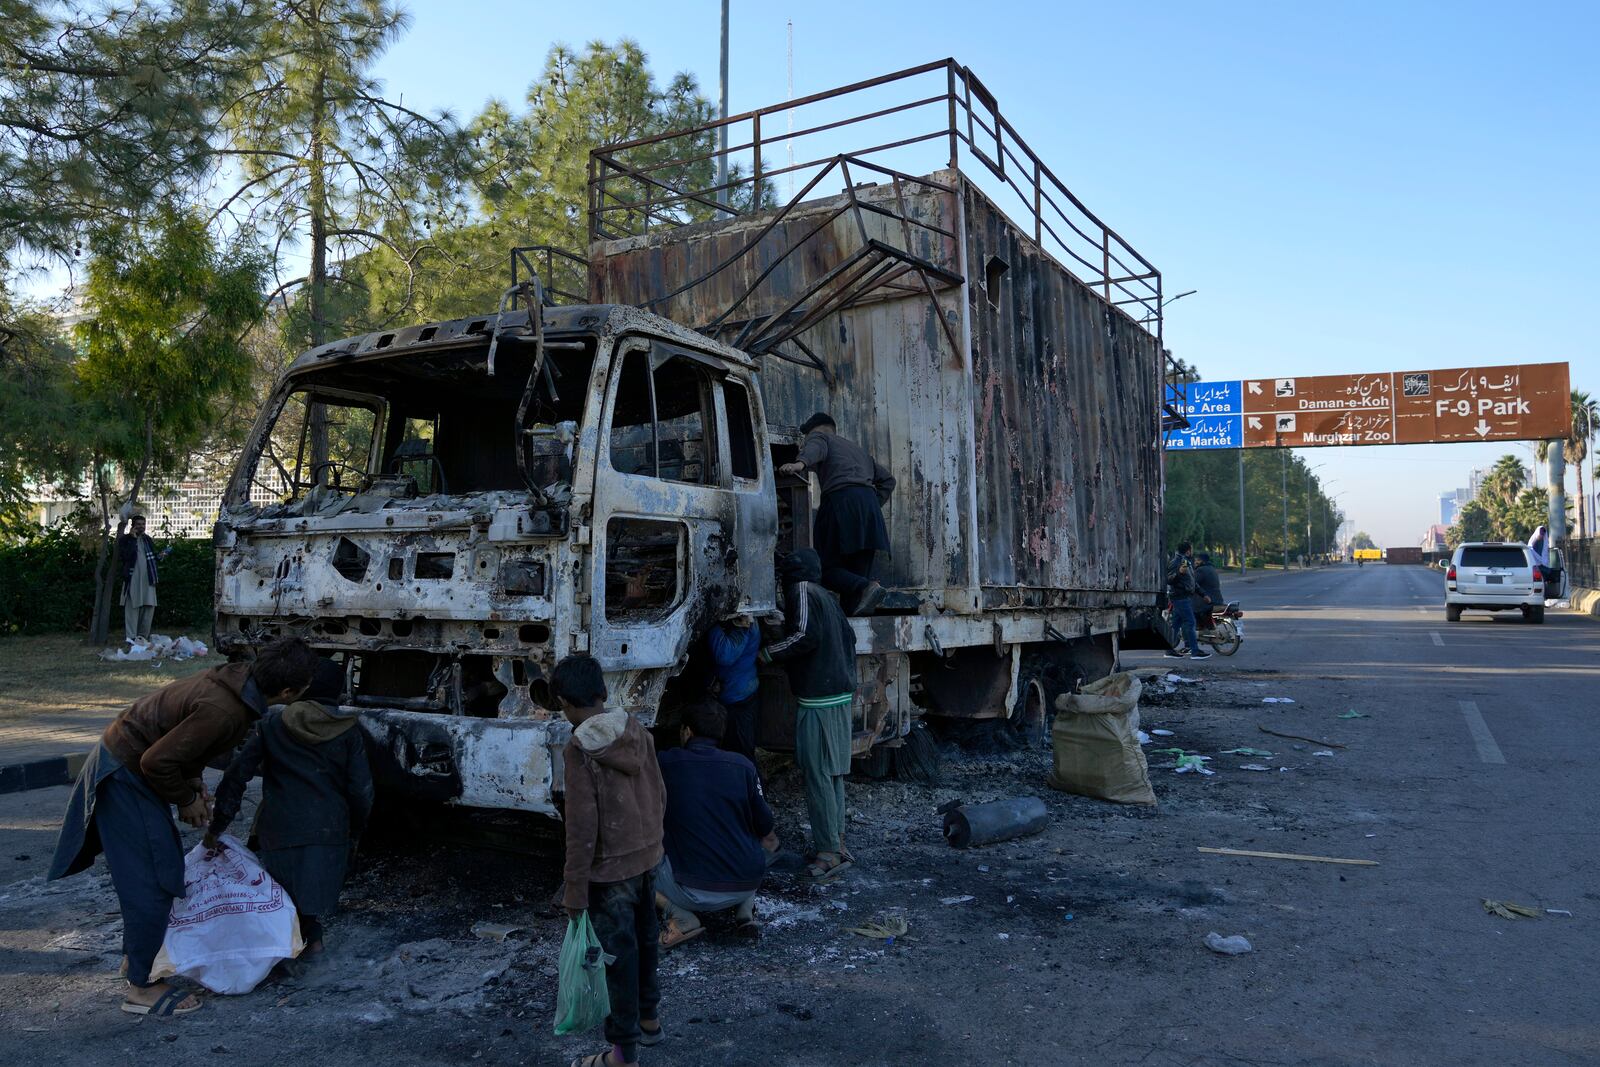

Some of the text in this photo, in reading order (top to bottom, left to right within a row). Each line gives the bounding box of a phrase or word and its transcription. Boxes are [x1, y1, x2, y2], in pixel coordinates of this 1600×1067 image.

[1360, 378, 1389, 396] دامن
[1443, 370, 1478, 398] پارک
[1170, 403, 1231, 413] lue Area
[1299, 396, 1389, 409] Daman-e-Koh
[1435, 398, 1531, 417] F-9 Park
[1190, 436, 1231, 446] Market
[1303, 431, 1390, 444] Murghzar Zoo
